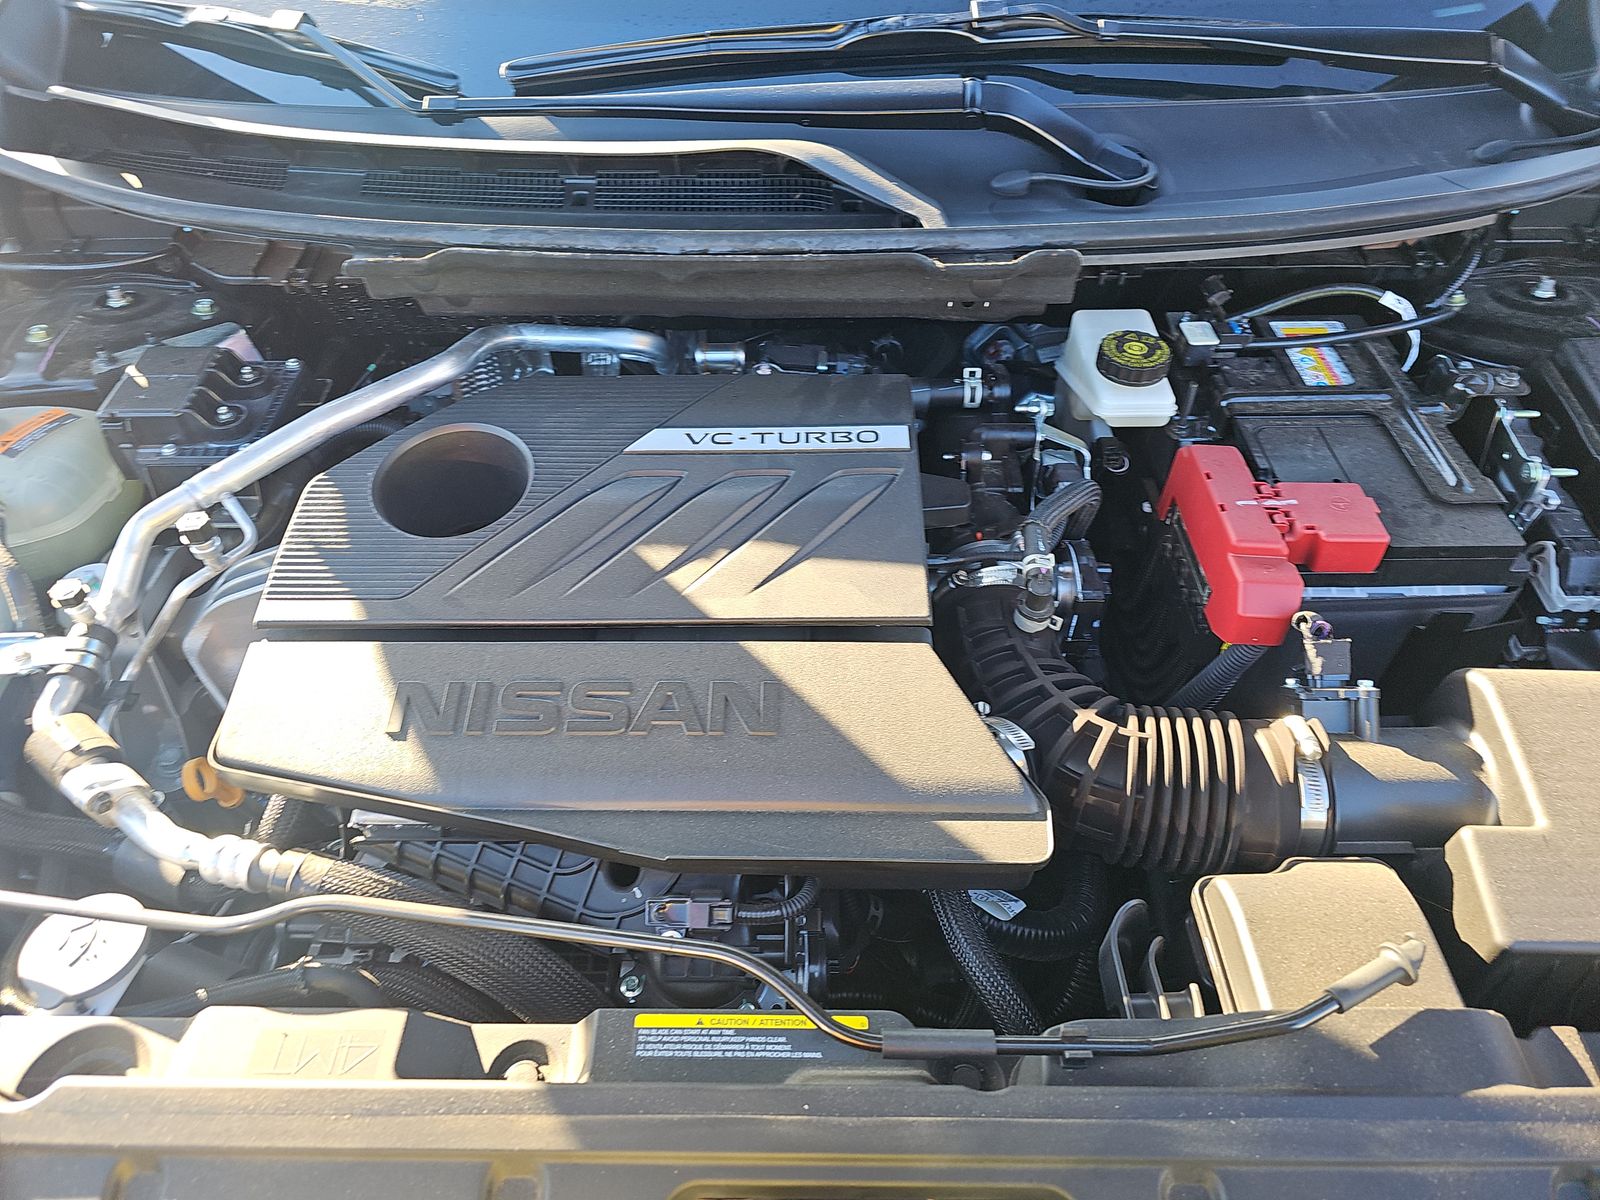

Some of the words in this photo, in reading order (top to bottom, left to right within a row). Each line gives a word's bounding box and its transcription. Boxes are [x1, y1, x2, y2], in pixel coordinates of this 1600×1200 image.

[385, 679, 781, 738] NISSAN
[710, 1018, 748, 1026] CAUTION
[759, 1018, 807, 1027] ATTENTION
